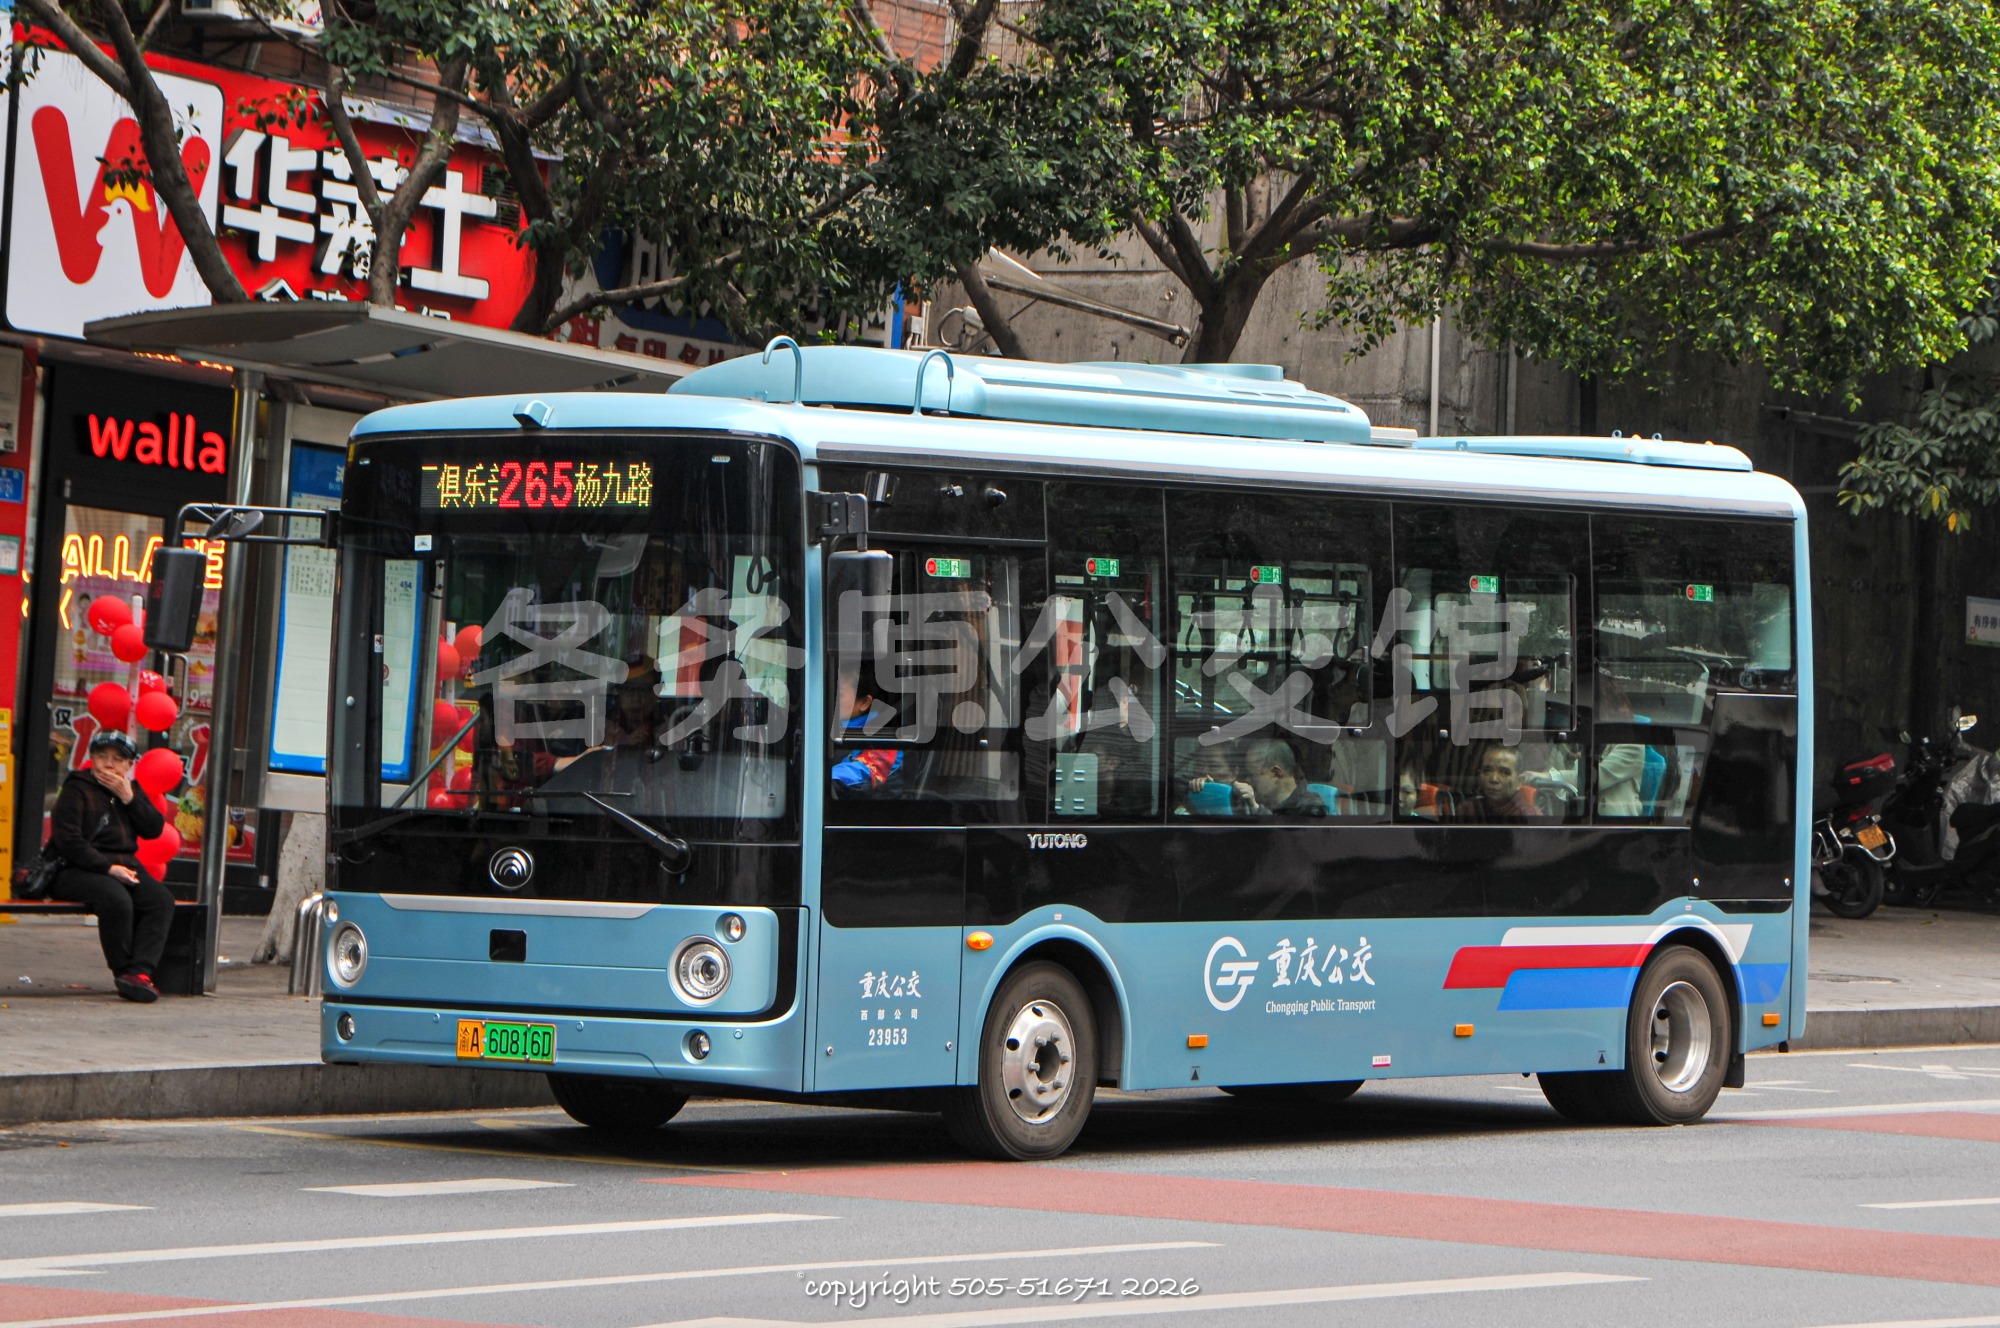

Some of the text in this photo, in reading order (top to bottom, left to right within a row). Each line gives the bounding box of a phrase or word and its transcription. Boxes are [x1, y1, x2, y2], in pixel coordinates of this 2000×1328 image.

[88, 411, 226, 475] walla
[498, 462, 573, 508] 265
[1027, 833, 1088, 849] YUTONG
[1268, 936, 1376, 988] 重庆公交
[859, 970, 921, 999] 重庆公交
[1265, 999, 1376, 1015] Chongqing Public Transport
[868, 1027, 908, 1046] 23953
